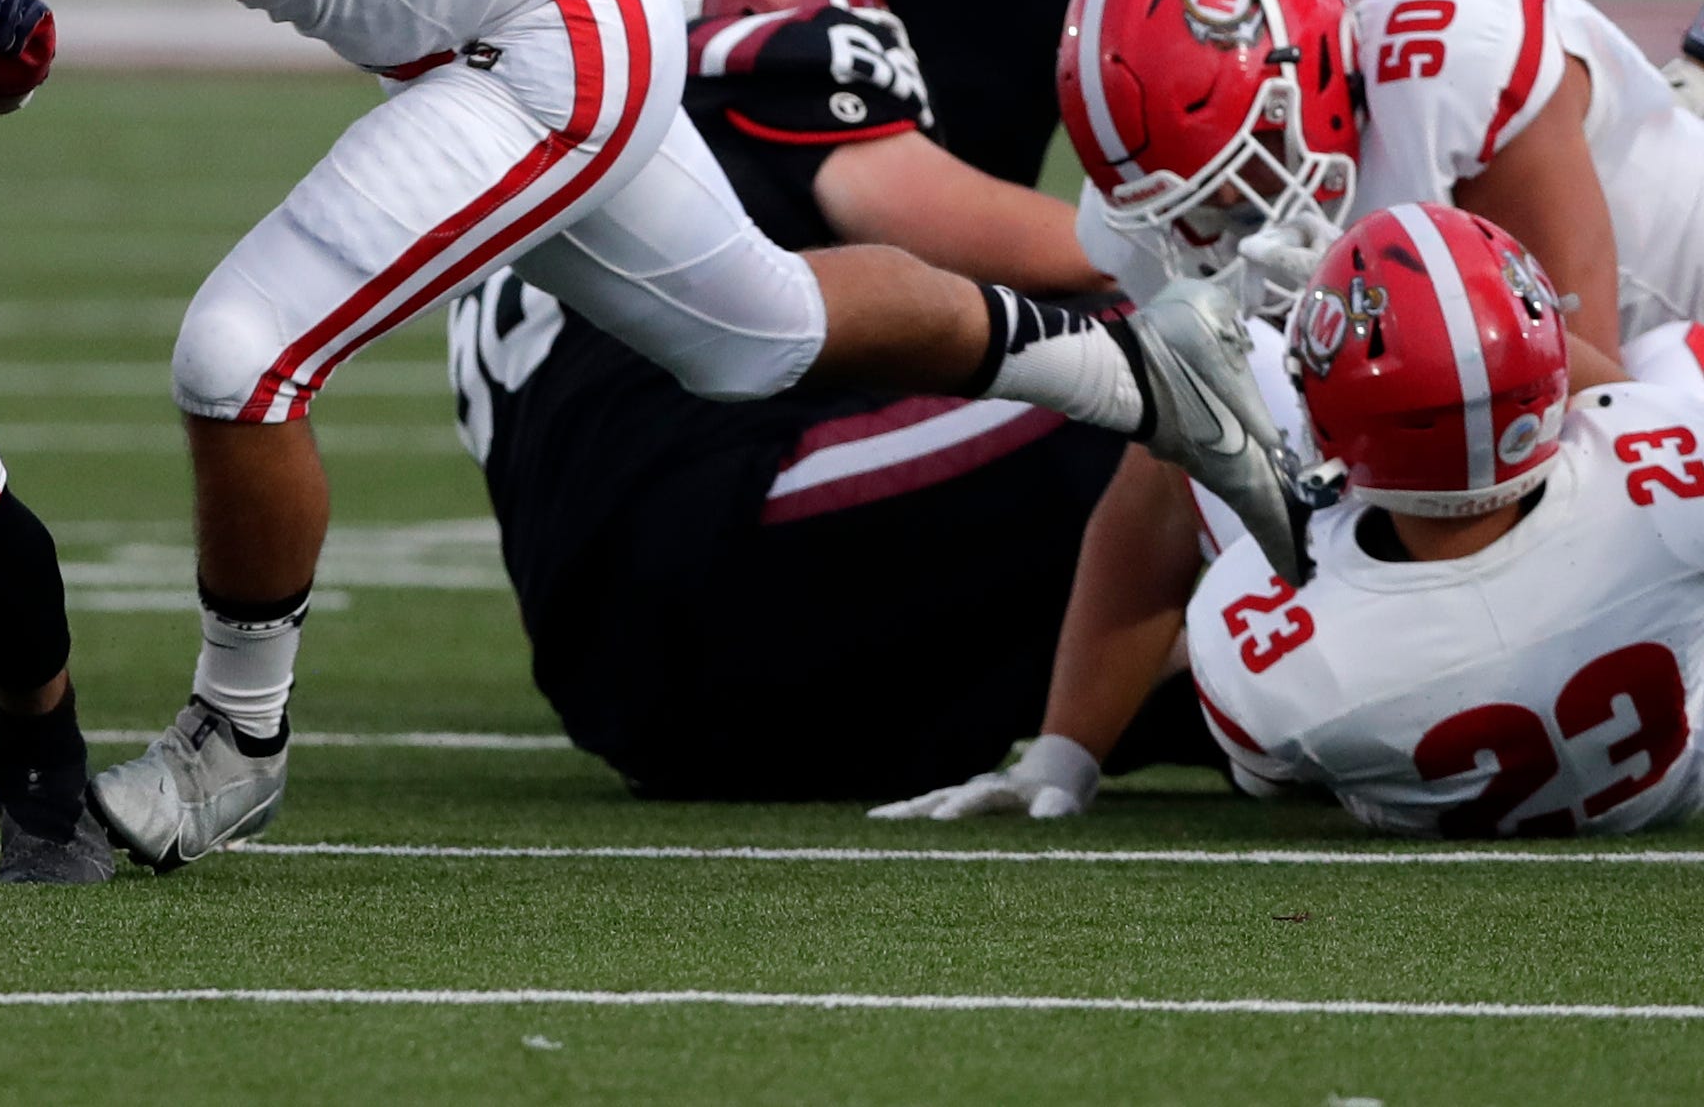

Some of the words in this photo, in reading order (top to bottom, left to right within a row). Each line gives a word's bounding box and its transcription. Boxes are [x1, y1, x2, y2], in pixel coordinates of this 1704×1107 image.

[1377, 0, 1456, 84] 50
[1615, 426, 1704, 507] 23
[1221, 574, 1315, 674] 23
[1413, 640, 1690, 839] 23
